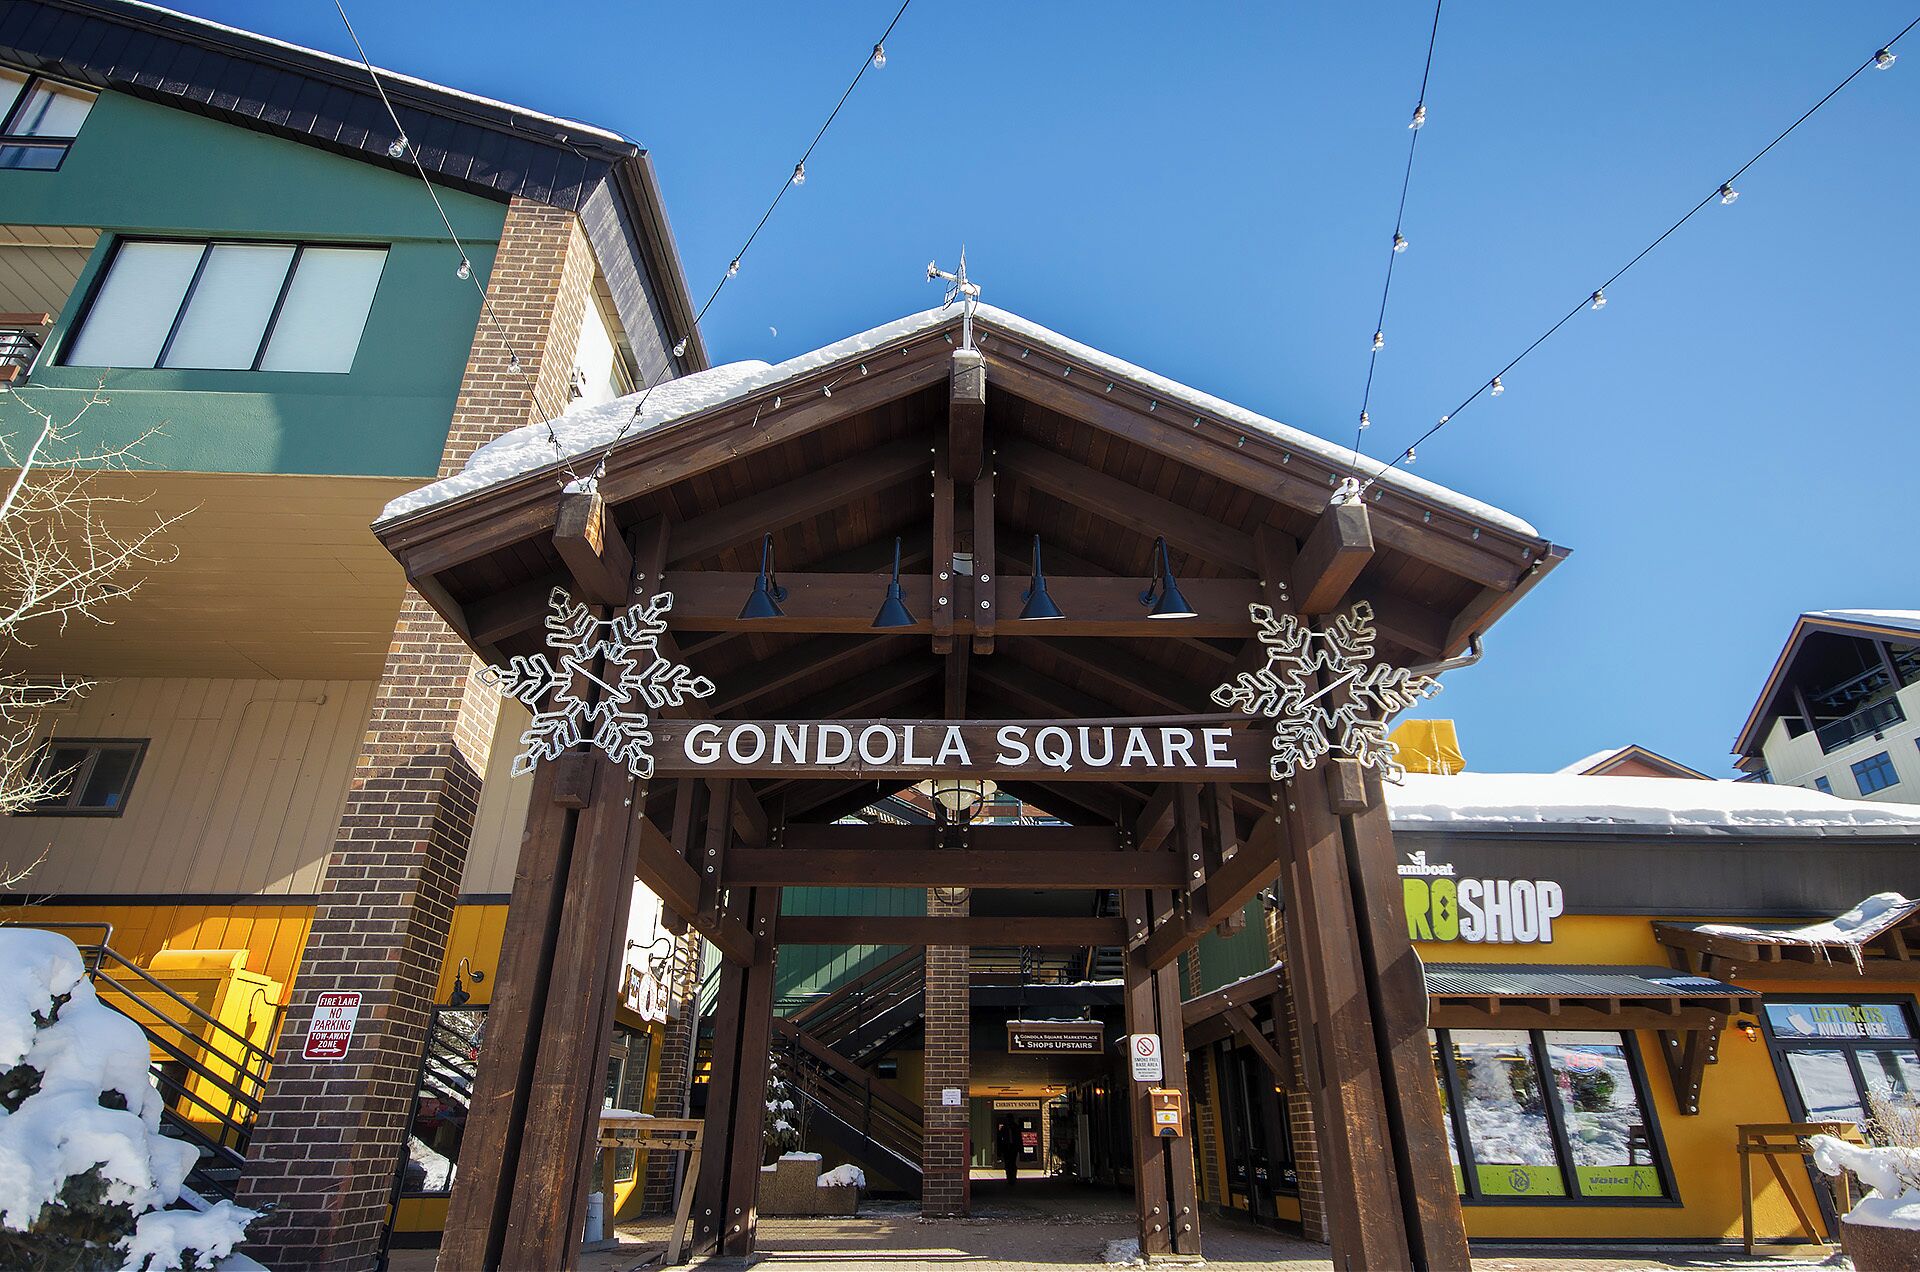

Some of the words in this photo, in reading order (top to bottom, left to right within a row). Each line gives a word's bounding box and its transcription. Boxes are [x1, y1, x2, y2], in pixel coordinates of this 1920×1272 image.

[683, 723, 973, 767] GONDOLA
[995, 725, 1238, 772] SQUARE
[1396, 853, 1456, 876] amboat
[1402, 878, 1565, 942] ROSHOP
[320, 997, 338, 1006] FIRE
[337, 997, 359, 1006] LANE
[328, 1008, 343, 1019] NO
[1809, 1006, 1834, 1022] LIFT
[1834, 1006, 1884, 1023] TICKETS
[313, 1019, 352, 1030] PARKING
[1817, 1023, 1866, 1036] AVAILABLE
[1864, 1023, 1889, 1036] HERE
[311, 1032, 349, 1040] TOW-AWAY
[317, 1040, 338, 1048] ZONE
[1027, 1041, 1054, 1049] SHOPS
[1055, 1041, 1093, 1049] UPSTAIRS
